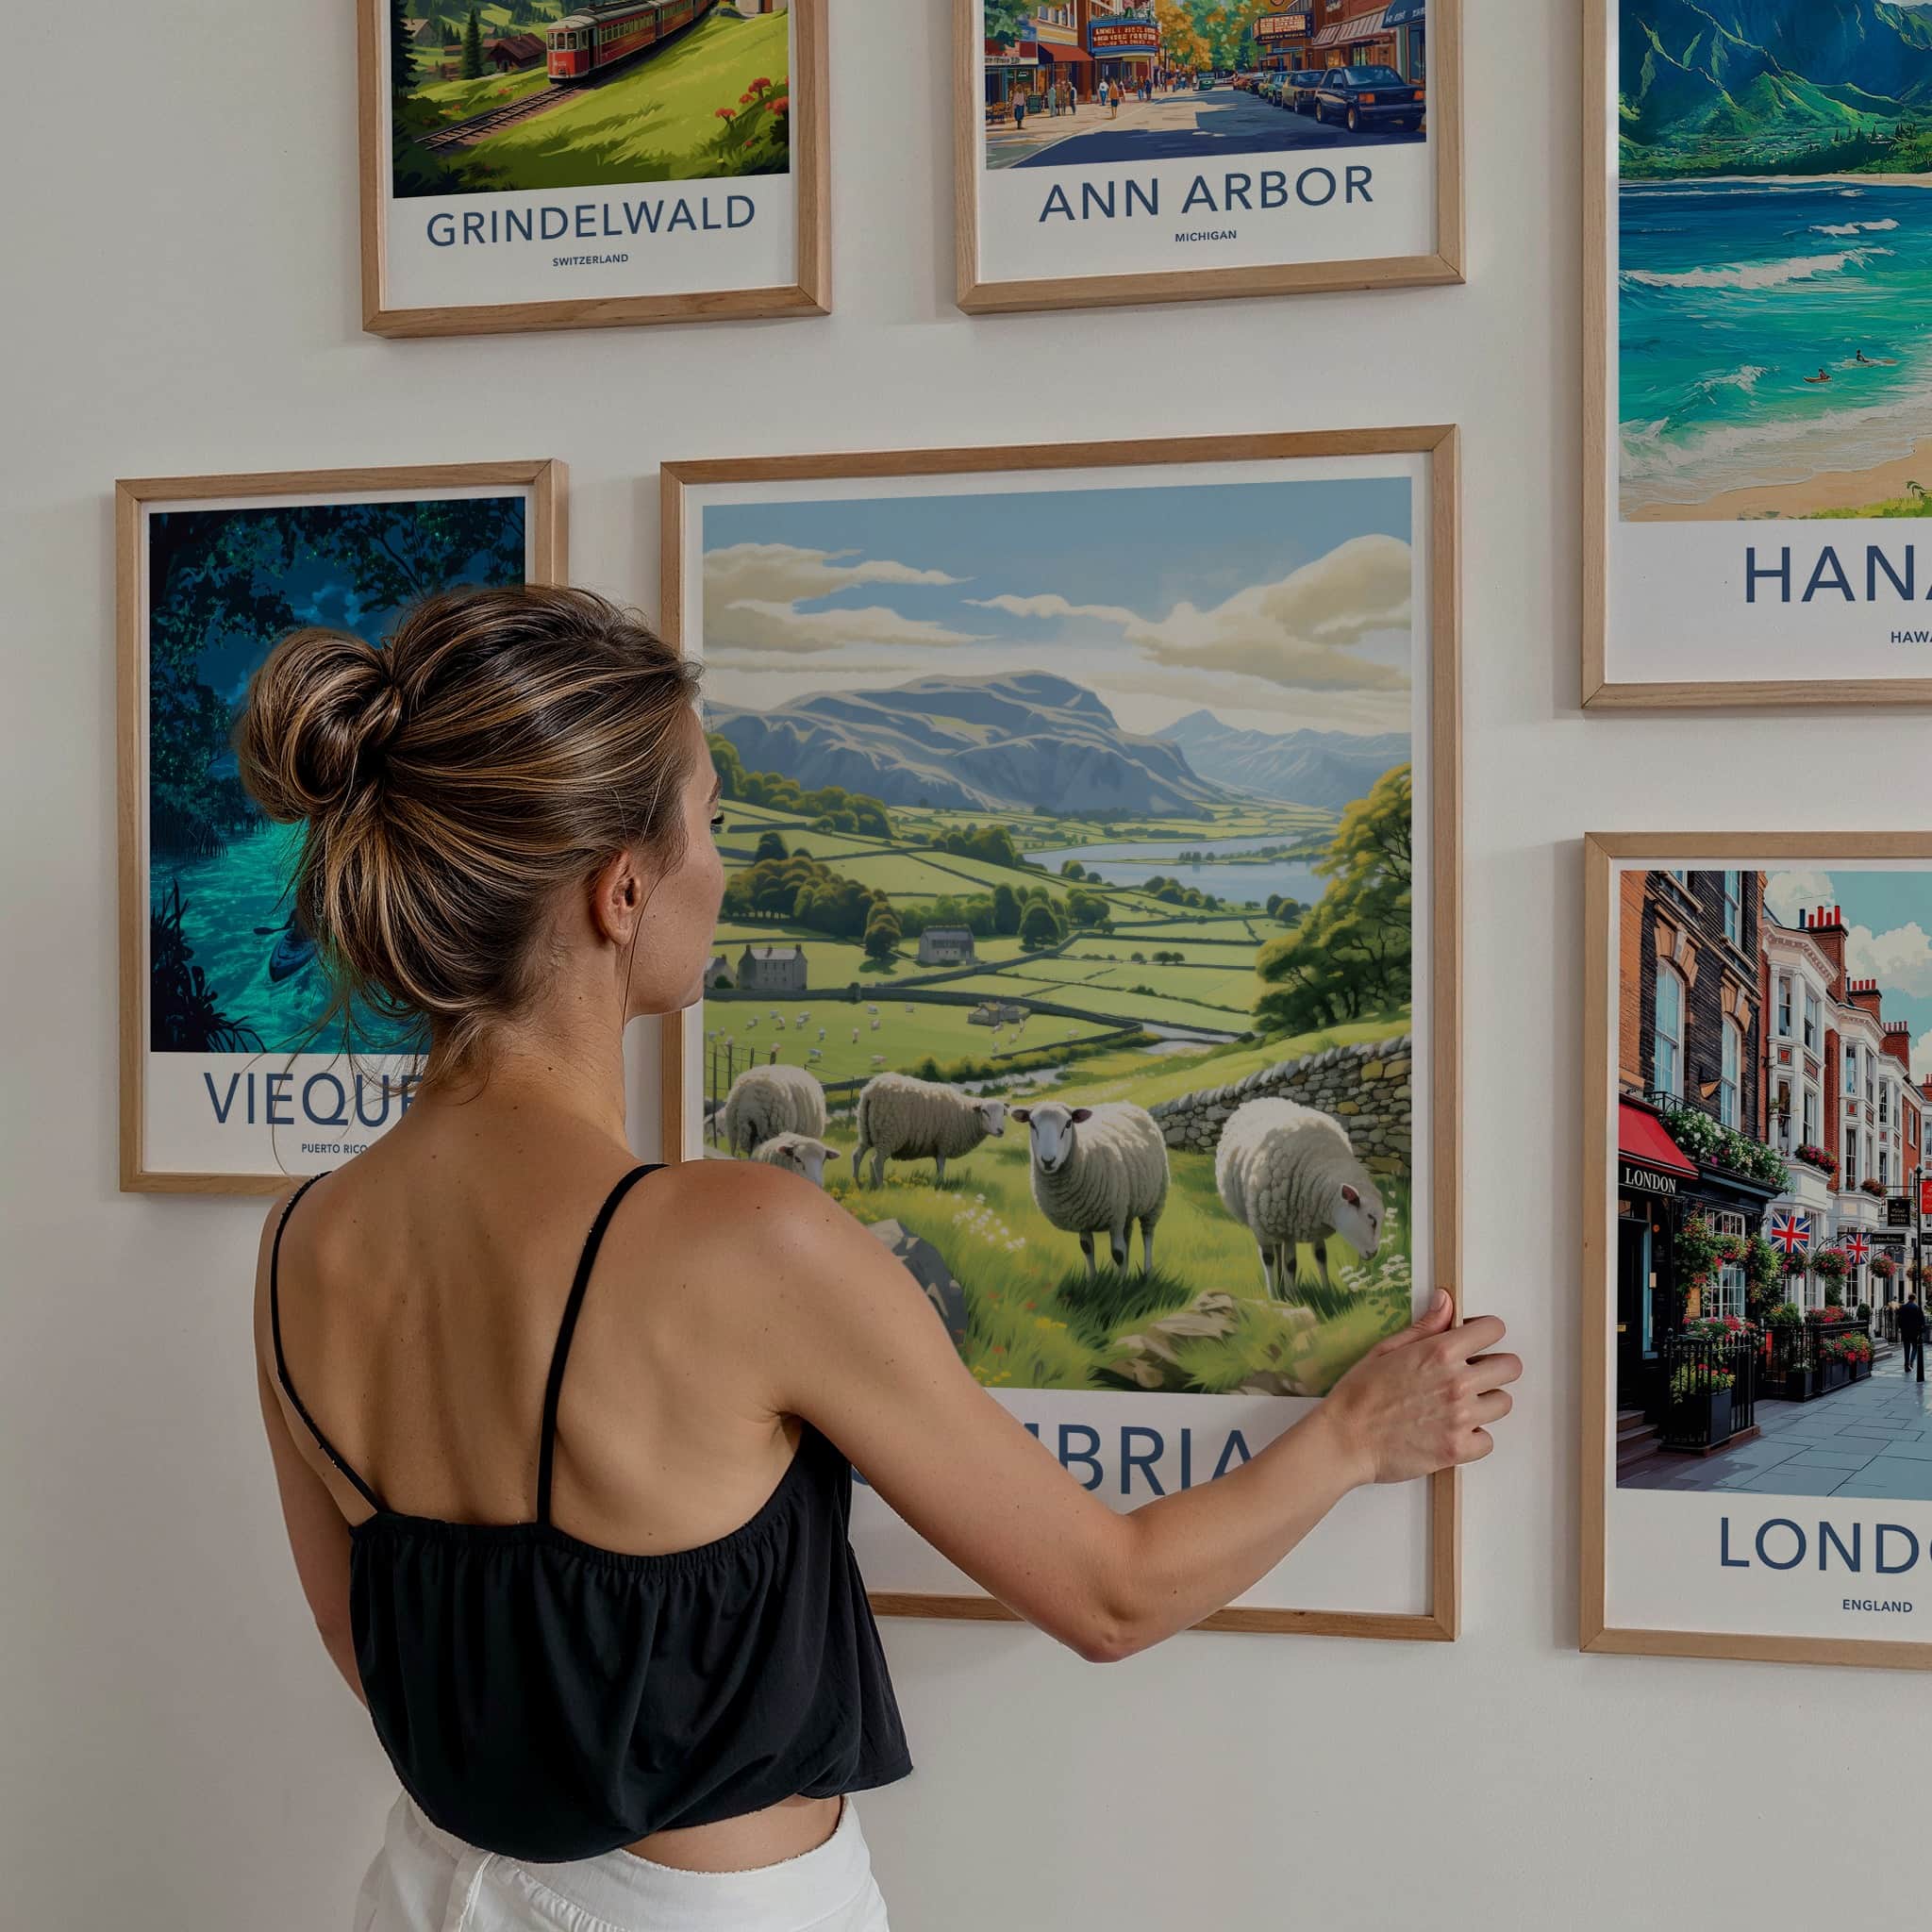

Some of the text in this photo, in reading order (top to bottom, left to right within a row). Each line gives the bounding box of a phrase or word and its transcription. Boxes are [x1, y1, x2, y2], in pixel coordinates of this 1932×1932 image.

[1039, 165, 1374, 223] ANN ARBOR
[427, 195, 756, 246] GRINDELWALD
[1174, 229, 1237, 242] MICHIGAN
[552, 254, 629, 267] SWITZERLAND
[1746, 544, 1932, 604] HAN
[1890, 630, 1932, 643] HAW
[301, 1143, 341, 1154] PUERTO
[1624, 1167, 1676, 1194] LONDON
[1721, 1516, 1932, 1574] LOND
[1842, 1599, 1913, 1613] ENGLAND
